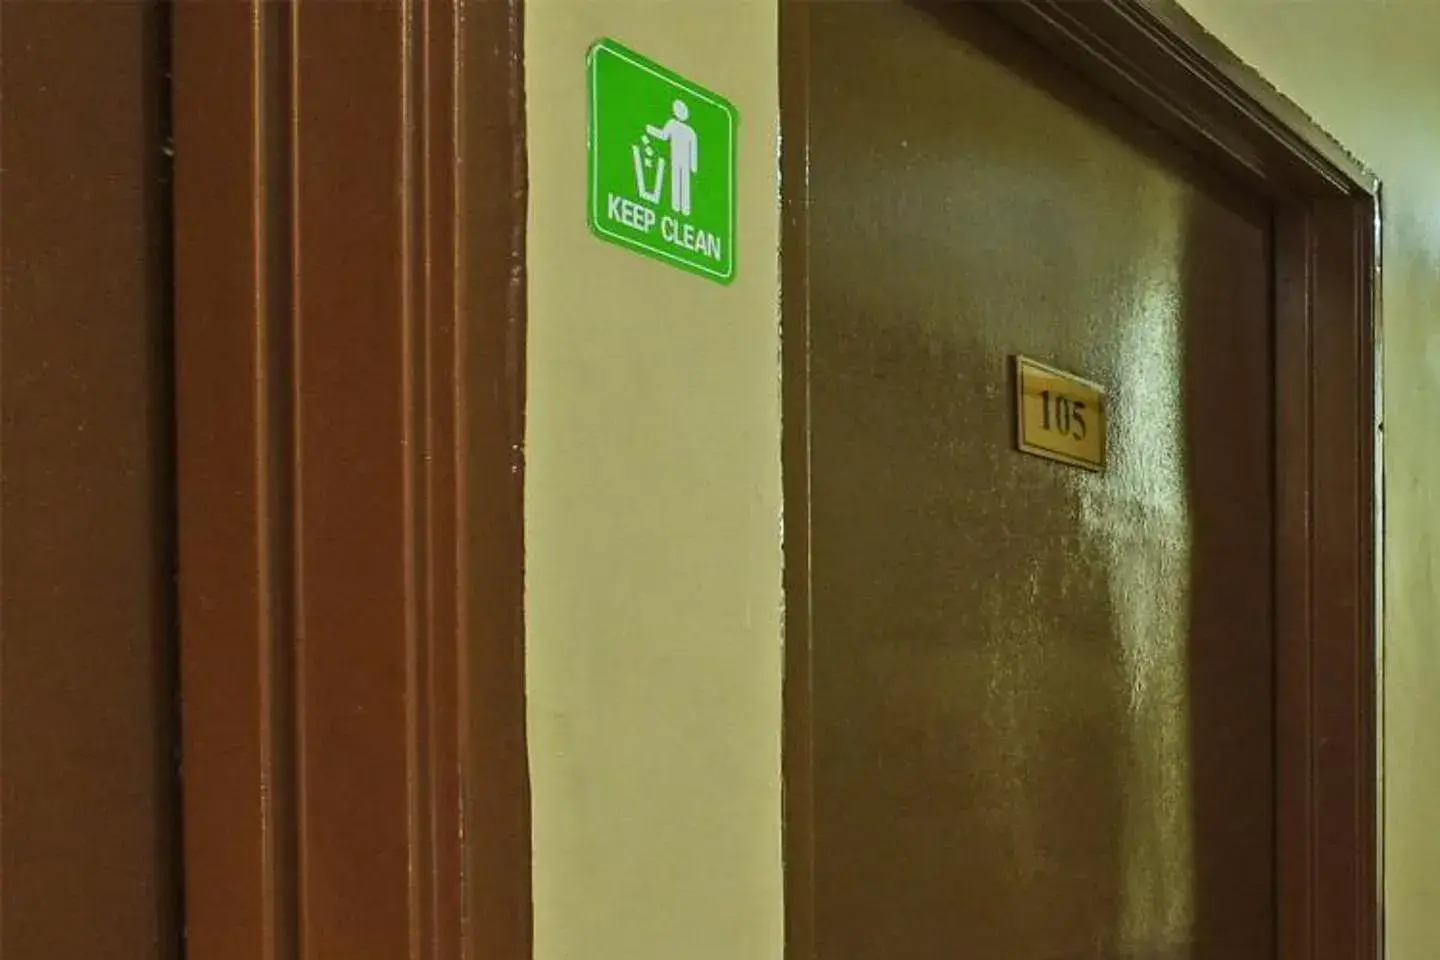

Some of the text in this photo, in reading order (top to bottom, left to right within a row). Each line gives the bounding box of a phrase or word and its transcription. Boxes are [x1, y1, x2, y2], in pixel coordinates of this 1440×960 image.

[608, 193, 721, 261] KEEP CLEAN
[1039, 390, 1086, 441] 105
